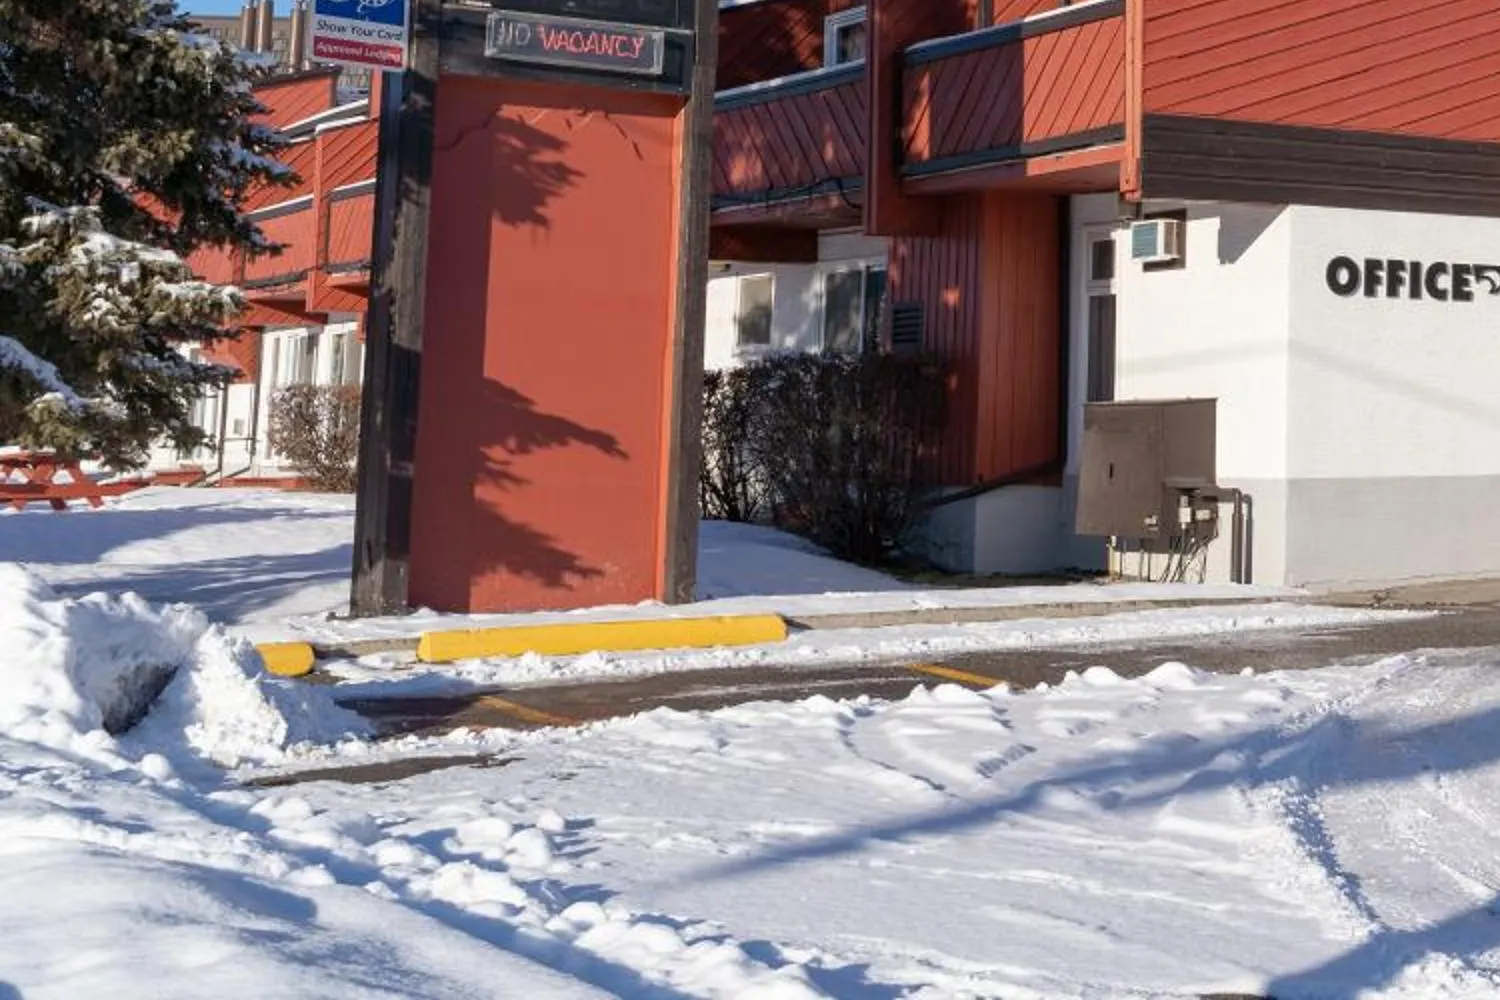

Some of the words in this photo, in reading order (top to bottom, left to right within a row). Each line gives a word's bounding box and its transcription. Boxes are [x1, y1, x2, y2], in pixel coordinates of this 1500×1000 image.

[316, 19, 347, 34] Show
[351, 24, 376, 37] Your
[377, 28, 403, 41] Card
[498, 21, 532, 46] NO
[537, 24, 645, 60] VACANCY
[1326, 255, 1474, 302] OFFICE
